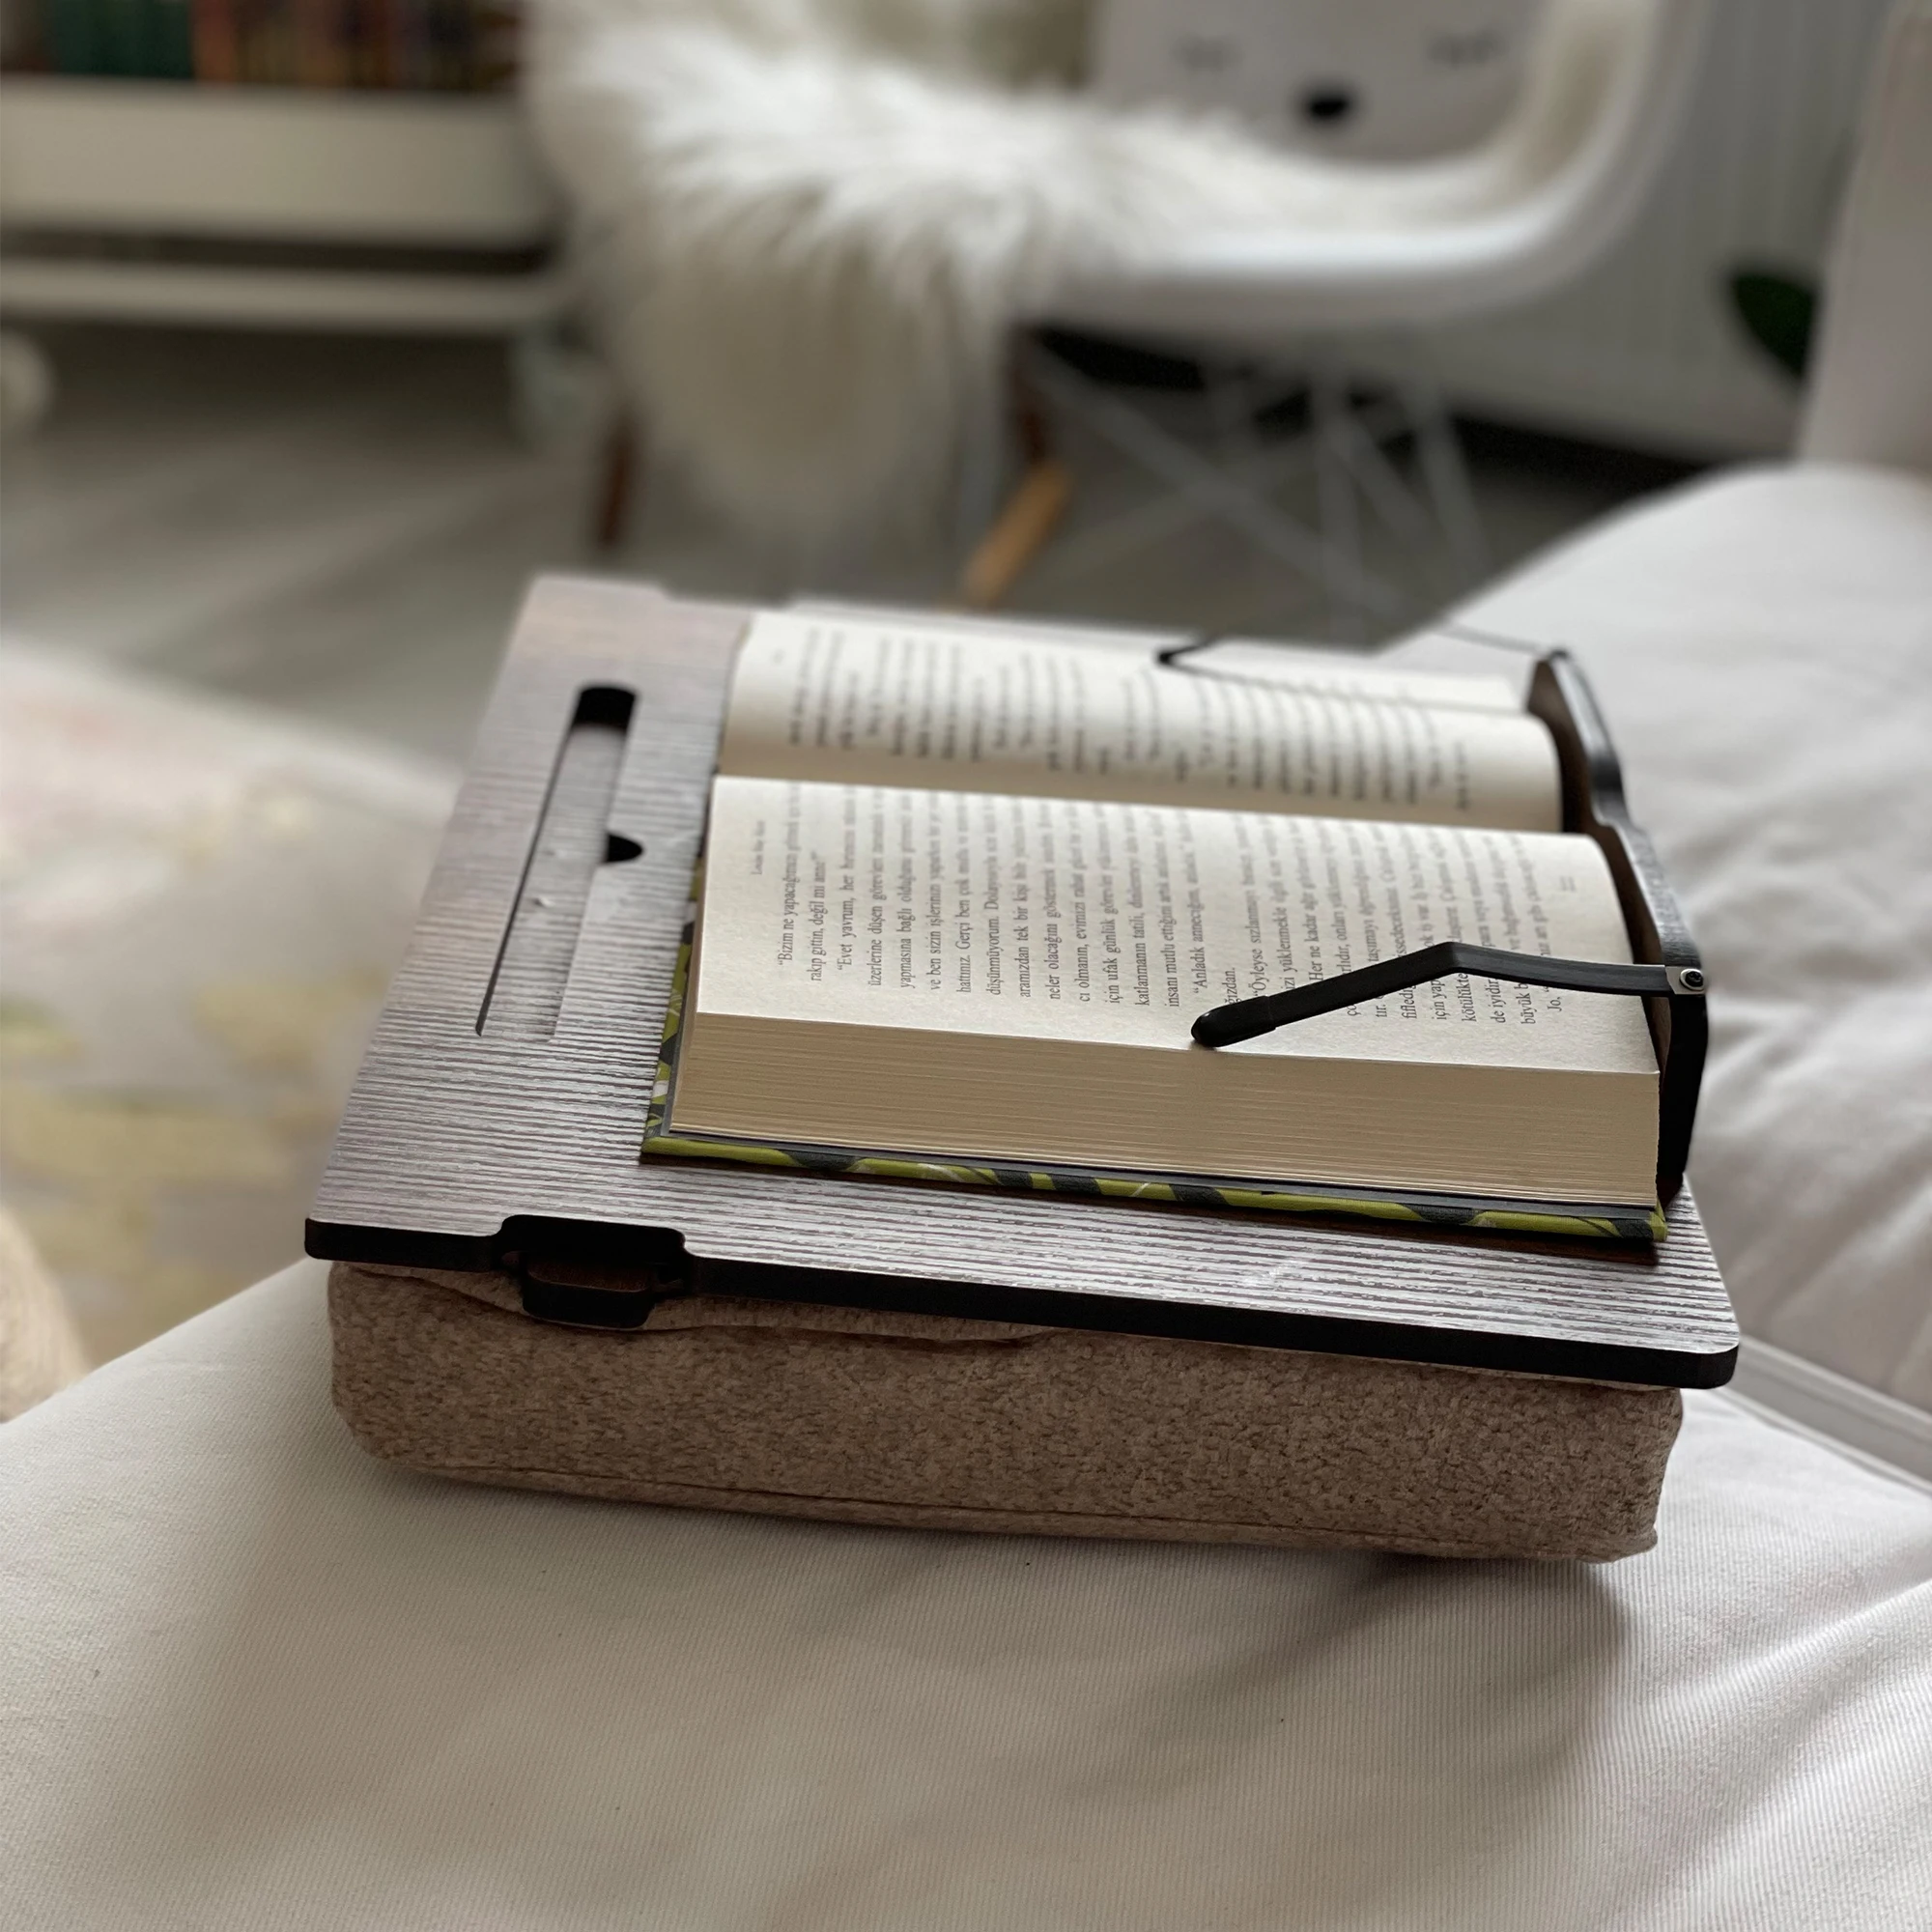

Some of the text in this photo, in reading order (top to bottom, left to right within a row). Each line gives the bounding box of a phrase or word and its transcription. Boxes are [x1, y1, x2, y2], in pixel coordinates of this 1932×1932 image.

[839, 875, 854, 891] her
[810, 900, 828, 924] değil
[841, 897, 857, 938] yavrum,
[867, 906, 885, 934] düşen
[896, 908, 916, 932] bağlı
[956, 899, 971, 917] ben
[1013, 906, 1028, 920] bir
[1070, 901, 1088, 939] evimizi
[781, 919, 794, 929] ne
[954, 922, 974, 950] Gerçi
[1013, 925, 1029, 941] tek
[1100, 919, 1121, 953] günlük
[1304, 914, 1320, 942] kadar
[926, 931, 941, 954] sizin
[1043, 923, 1062, 970] olacağını
[1309, 945, 1321, 958] ne
[1363, 920, 1381, 962] taşımayı
[837, 944, 853, 970] “Evet
[867, 939, 882, 986] üzerlerine
[898, 938, 915, 989] yapmasına
[926, 958, 941, 976] ben
[985, 917, 1005, 995] düşünmüyorum.
[1074, 944, 1090, 988] olmanın,
[1103, 958, 1119, 980] ufak
[1160, 944, 1177, 974] mutlu
[1014, 947, 1031, 998] aramızdan
[1133, 943, 1150, 1006] katlanmanın
[1190, 947, 1208, 993] “Anladık
[1309, 961, 1323, 981] Her
[930, 980, 941, 990] ve
[1045, 975, 1061, 1000] neler
[1106, 984, 1123, 1004] için
[1164, 977, 1180, 1008] insanı
[1222, 967, 1241, 1005] ğızdan.
[1434, 1001, 1450, 1020] için
[1491, 1010, 1506, 1023] de
[1516, 993, 1537, 1024] büyük
[1547, 997, 1563, 1012] Jo,
